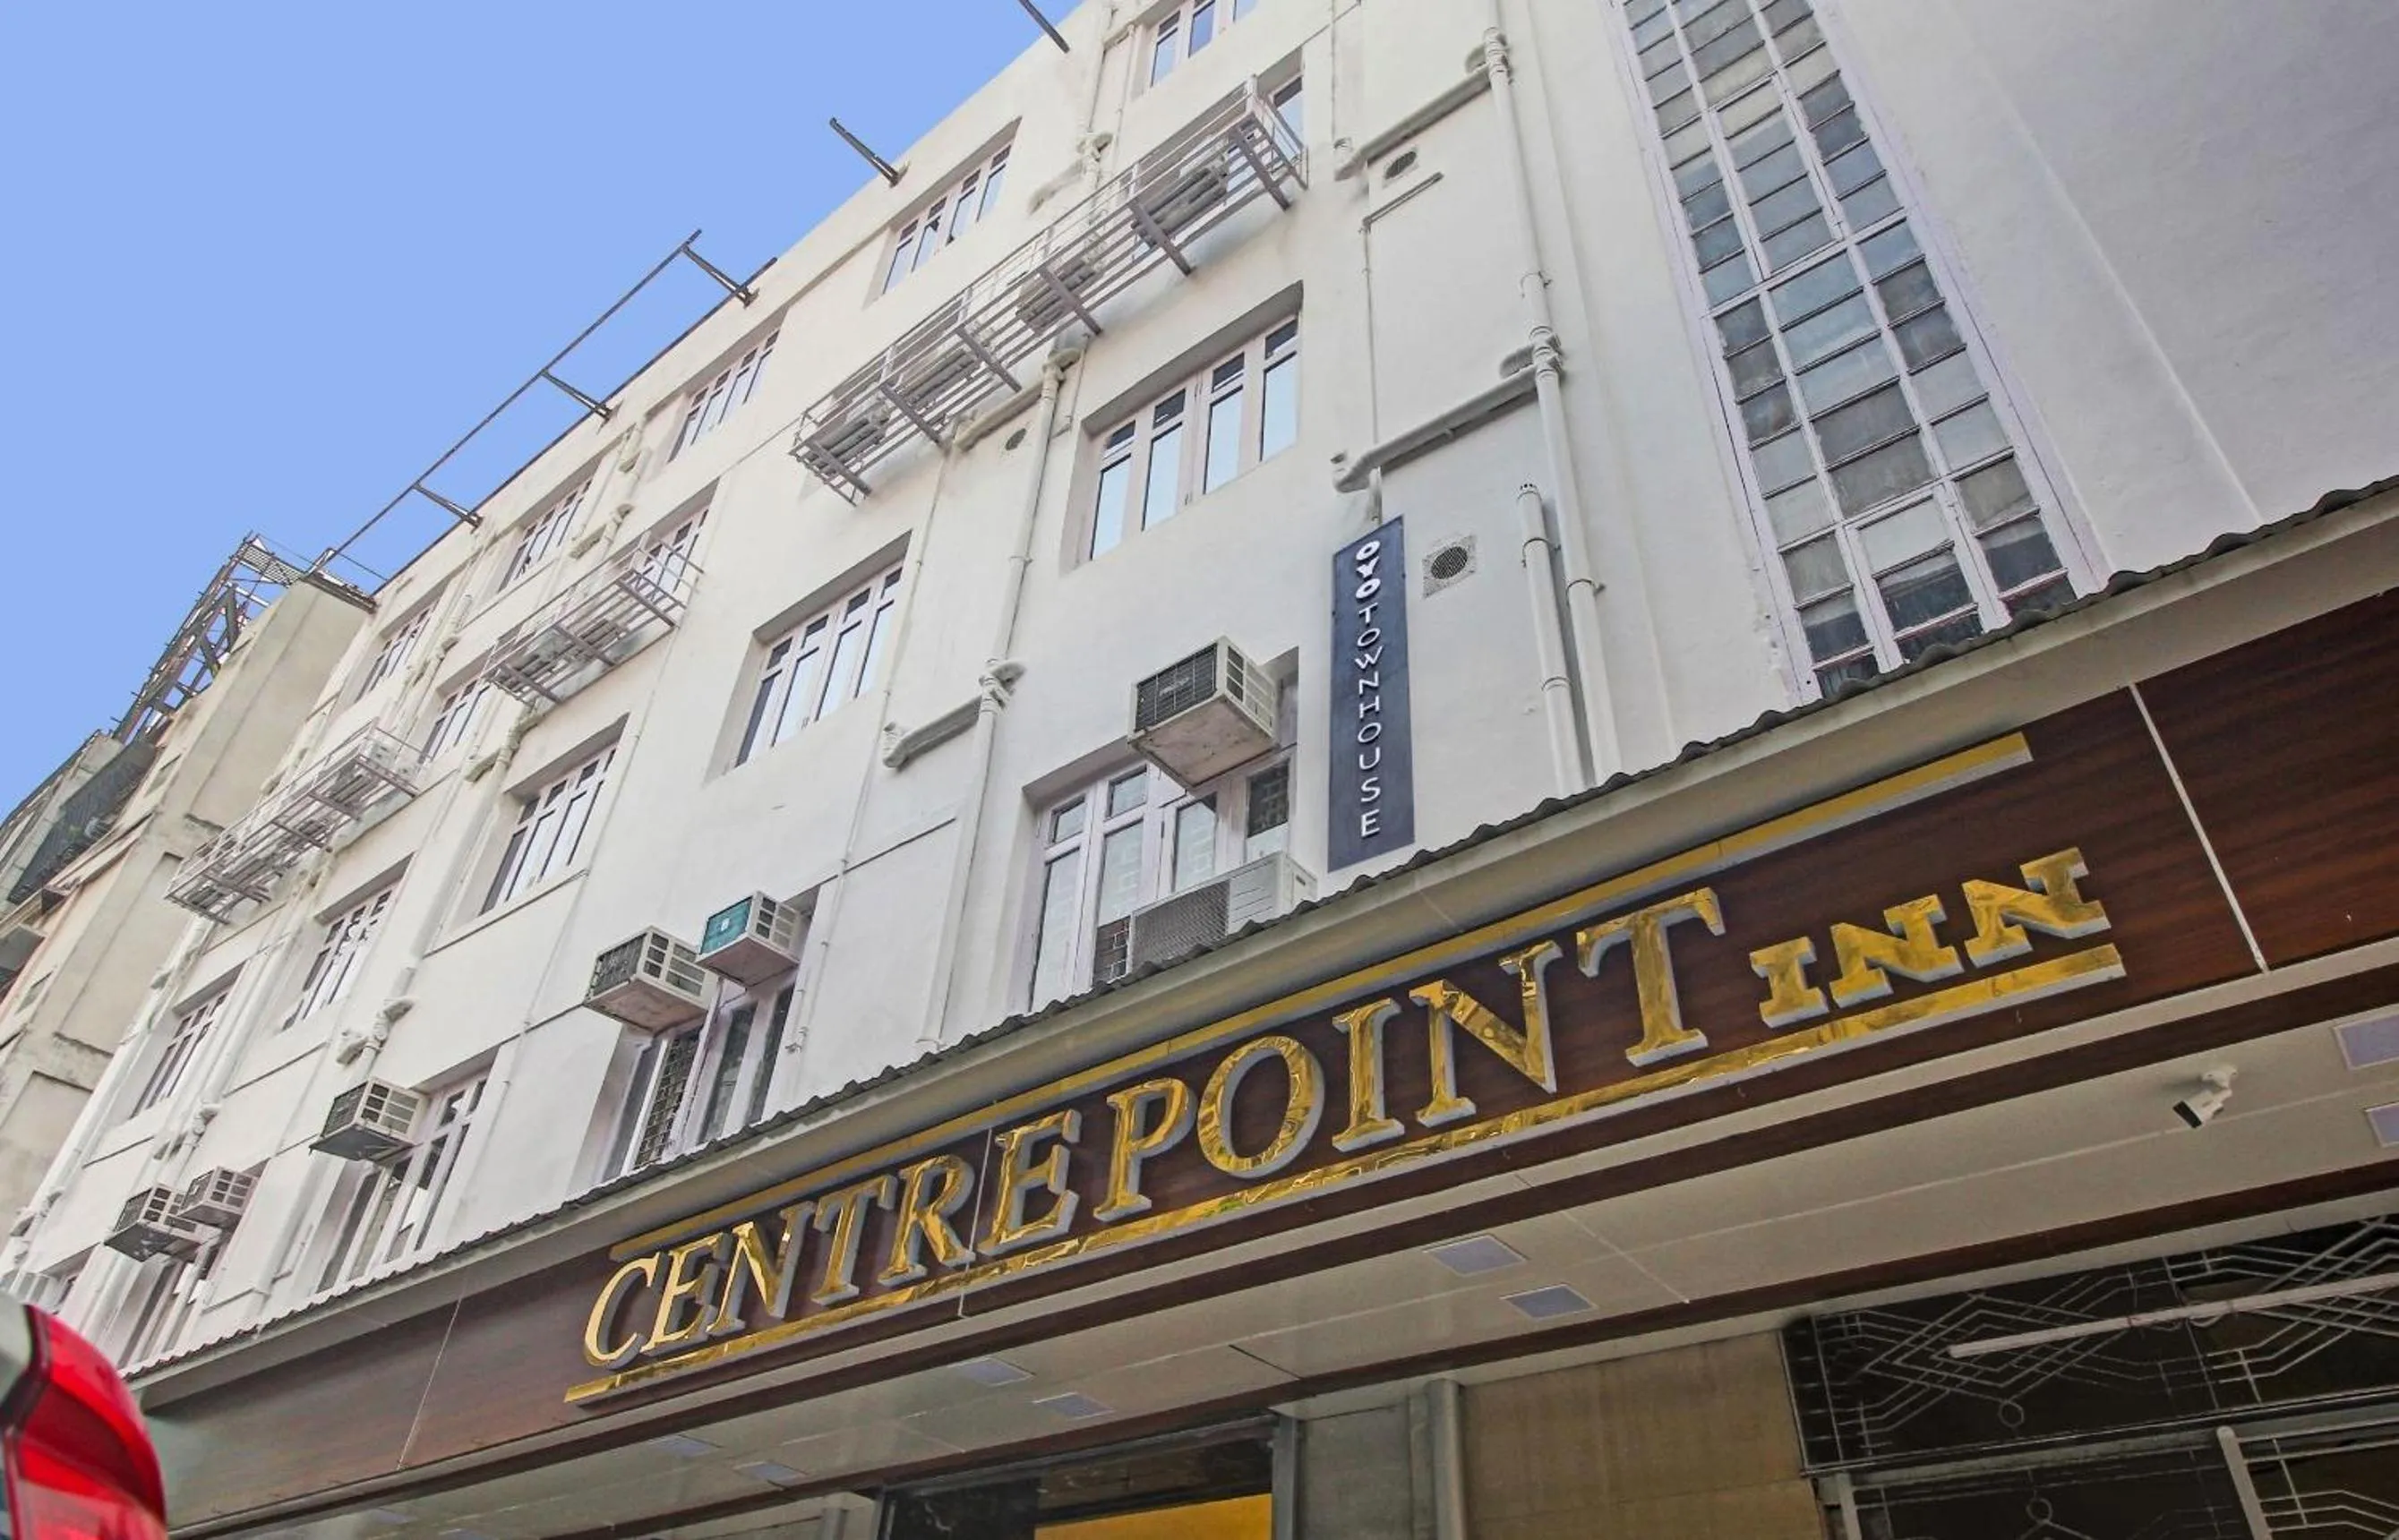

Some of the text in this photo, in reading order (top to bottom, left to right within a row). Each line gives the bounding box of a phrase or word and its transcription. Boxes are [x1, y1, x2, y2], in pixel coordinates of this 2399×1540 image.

[1355, 540, 1384, 837] OYO TOWNHOUSE
[1750, 847, 2112, 1028] INN
